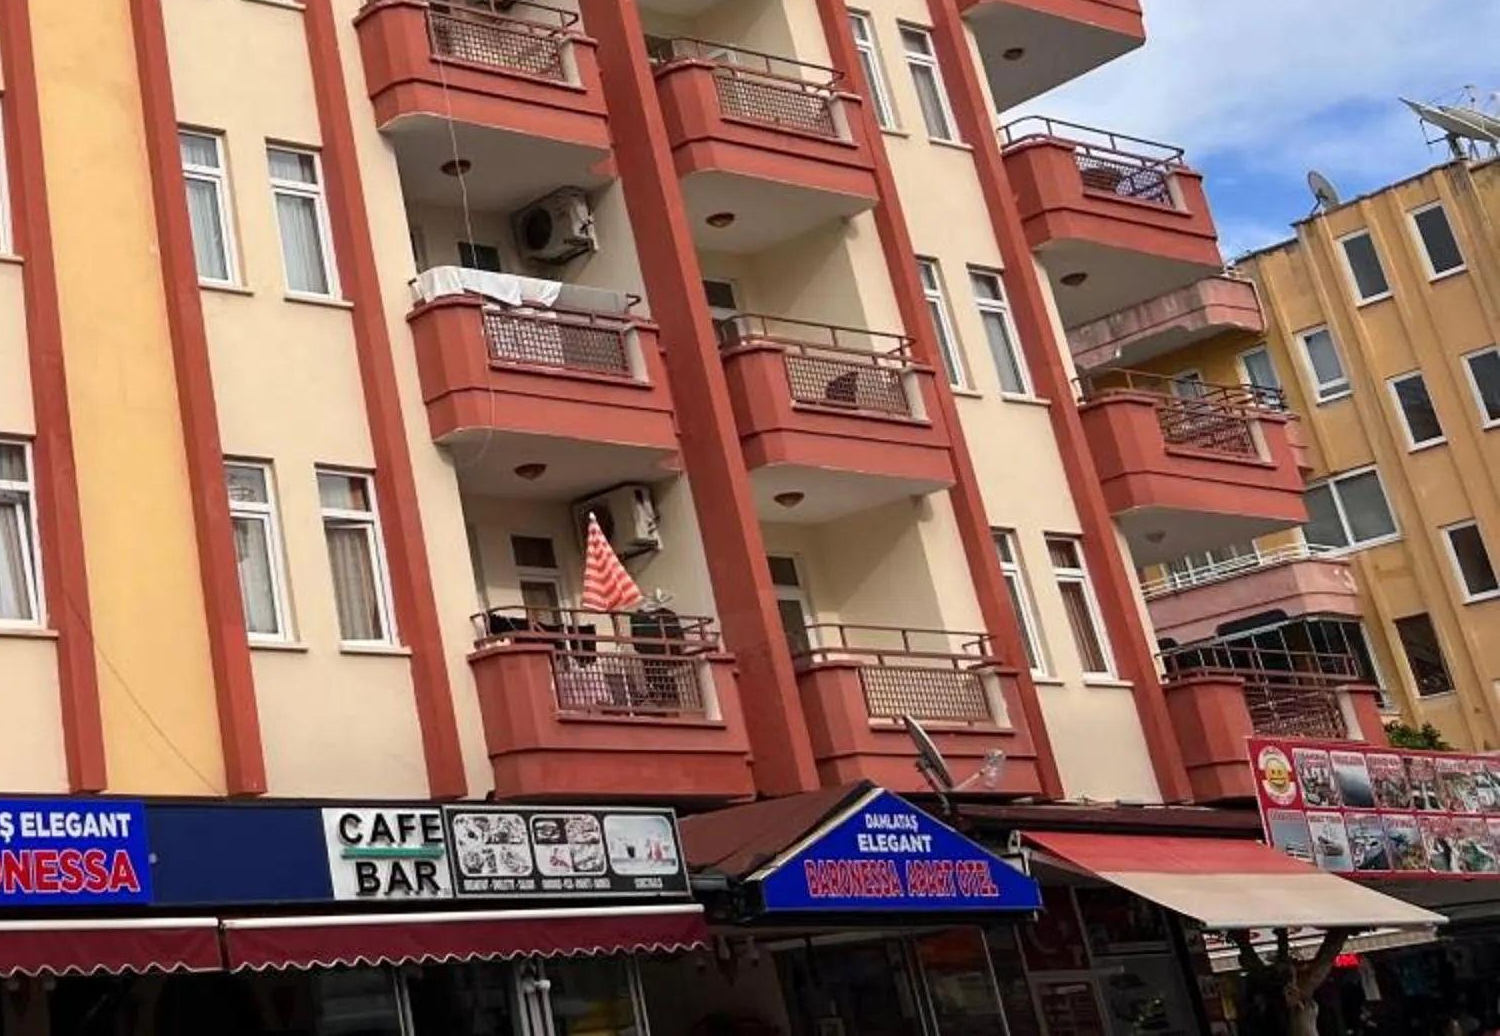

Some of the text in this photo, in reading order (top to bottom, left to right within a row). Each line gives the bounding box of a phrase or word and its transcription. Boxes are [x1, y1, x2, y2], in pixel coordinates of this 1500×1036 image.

[20, 812, 131, 838] ELEGANT
[339, 813, 443, 844] CAFE
[857, 814, 932, 852] DAMLATAŞ ELEGANT
[355, 860, 441, 896] BAR
[803, 859, 1000, 898] BARONESSA APART OTEL
